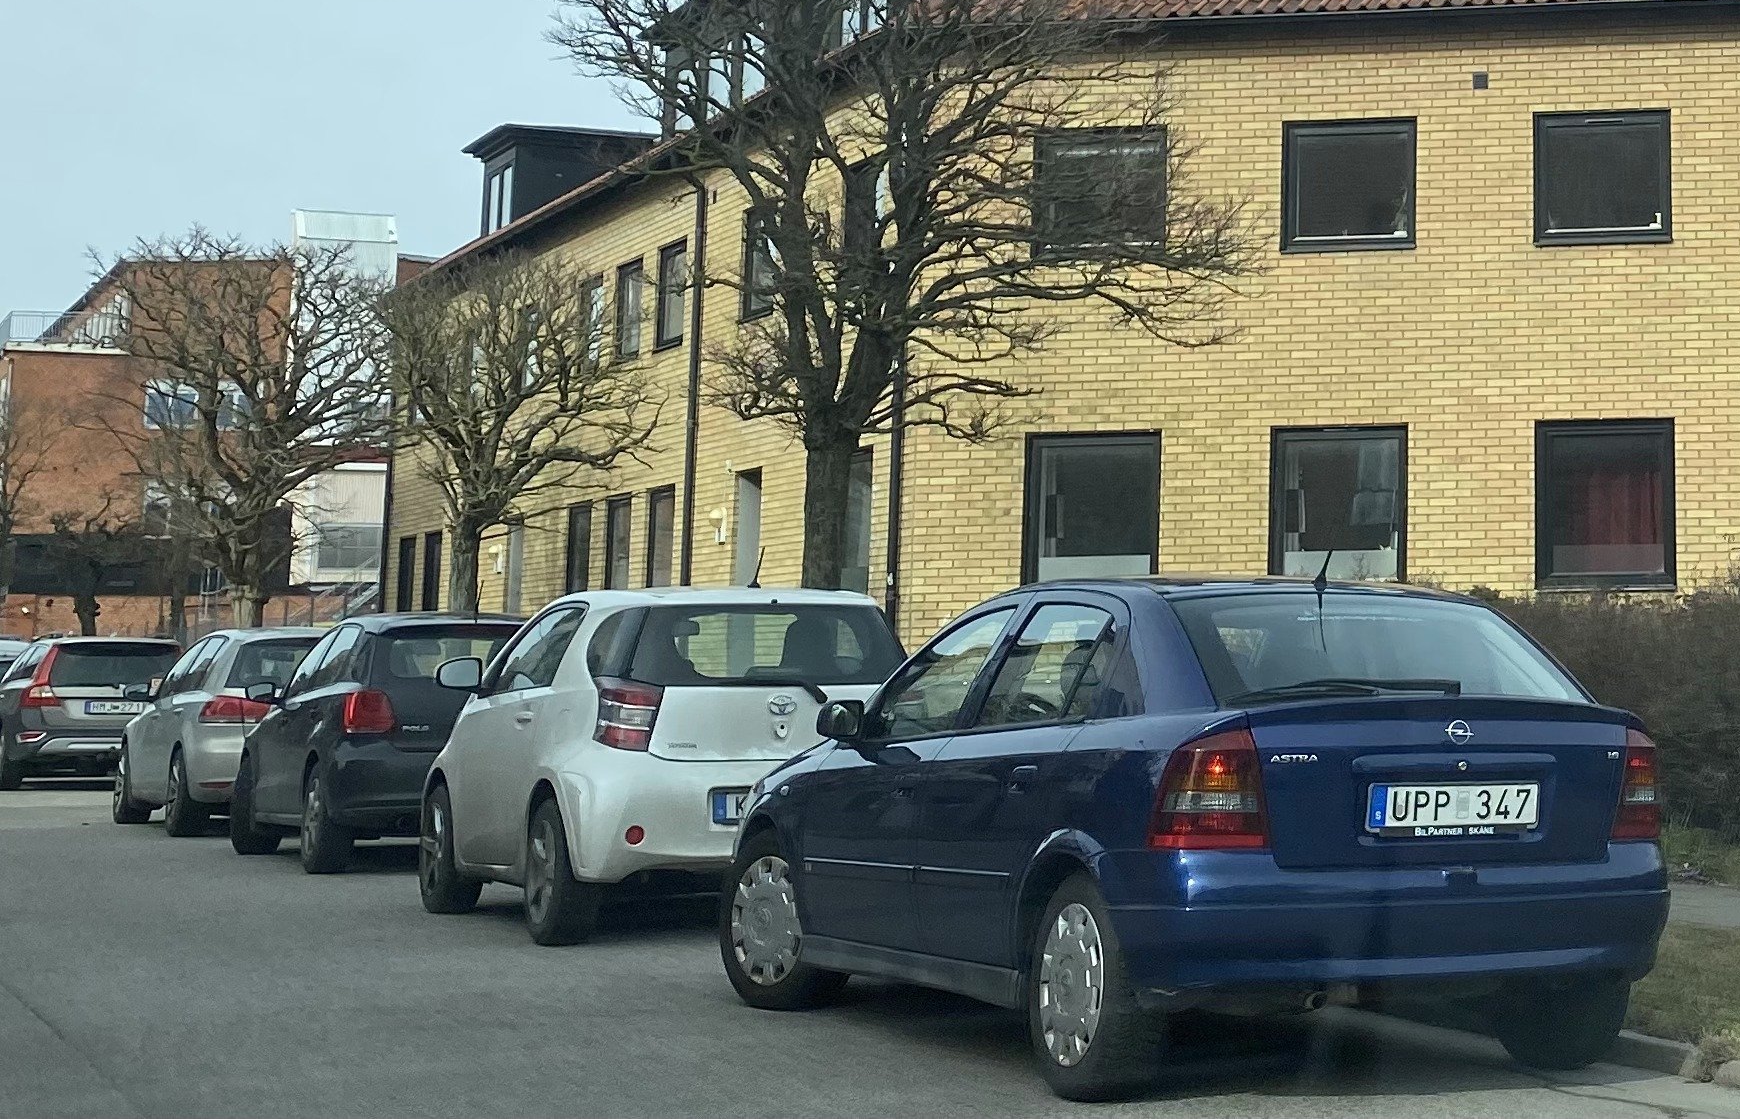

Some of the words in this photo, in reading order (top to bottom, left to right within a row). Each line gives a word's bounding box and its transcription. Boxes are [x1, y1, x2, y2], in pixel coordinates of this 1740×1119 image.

[1270, 754, 1319, 763] ASTRA
[1392, 790, 1450, 821] UPP
[1476, 788, 1531, 819] 347
[1374, 810, 1382, 821] S
